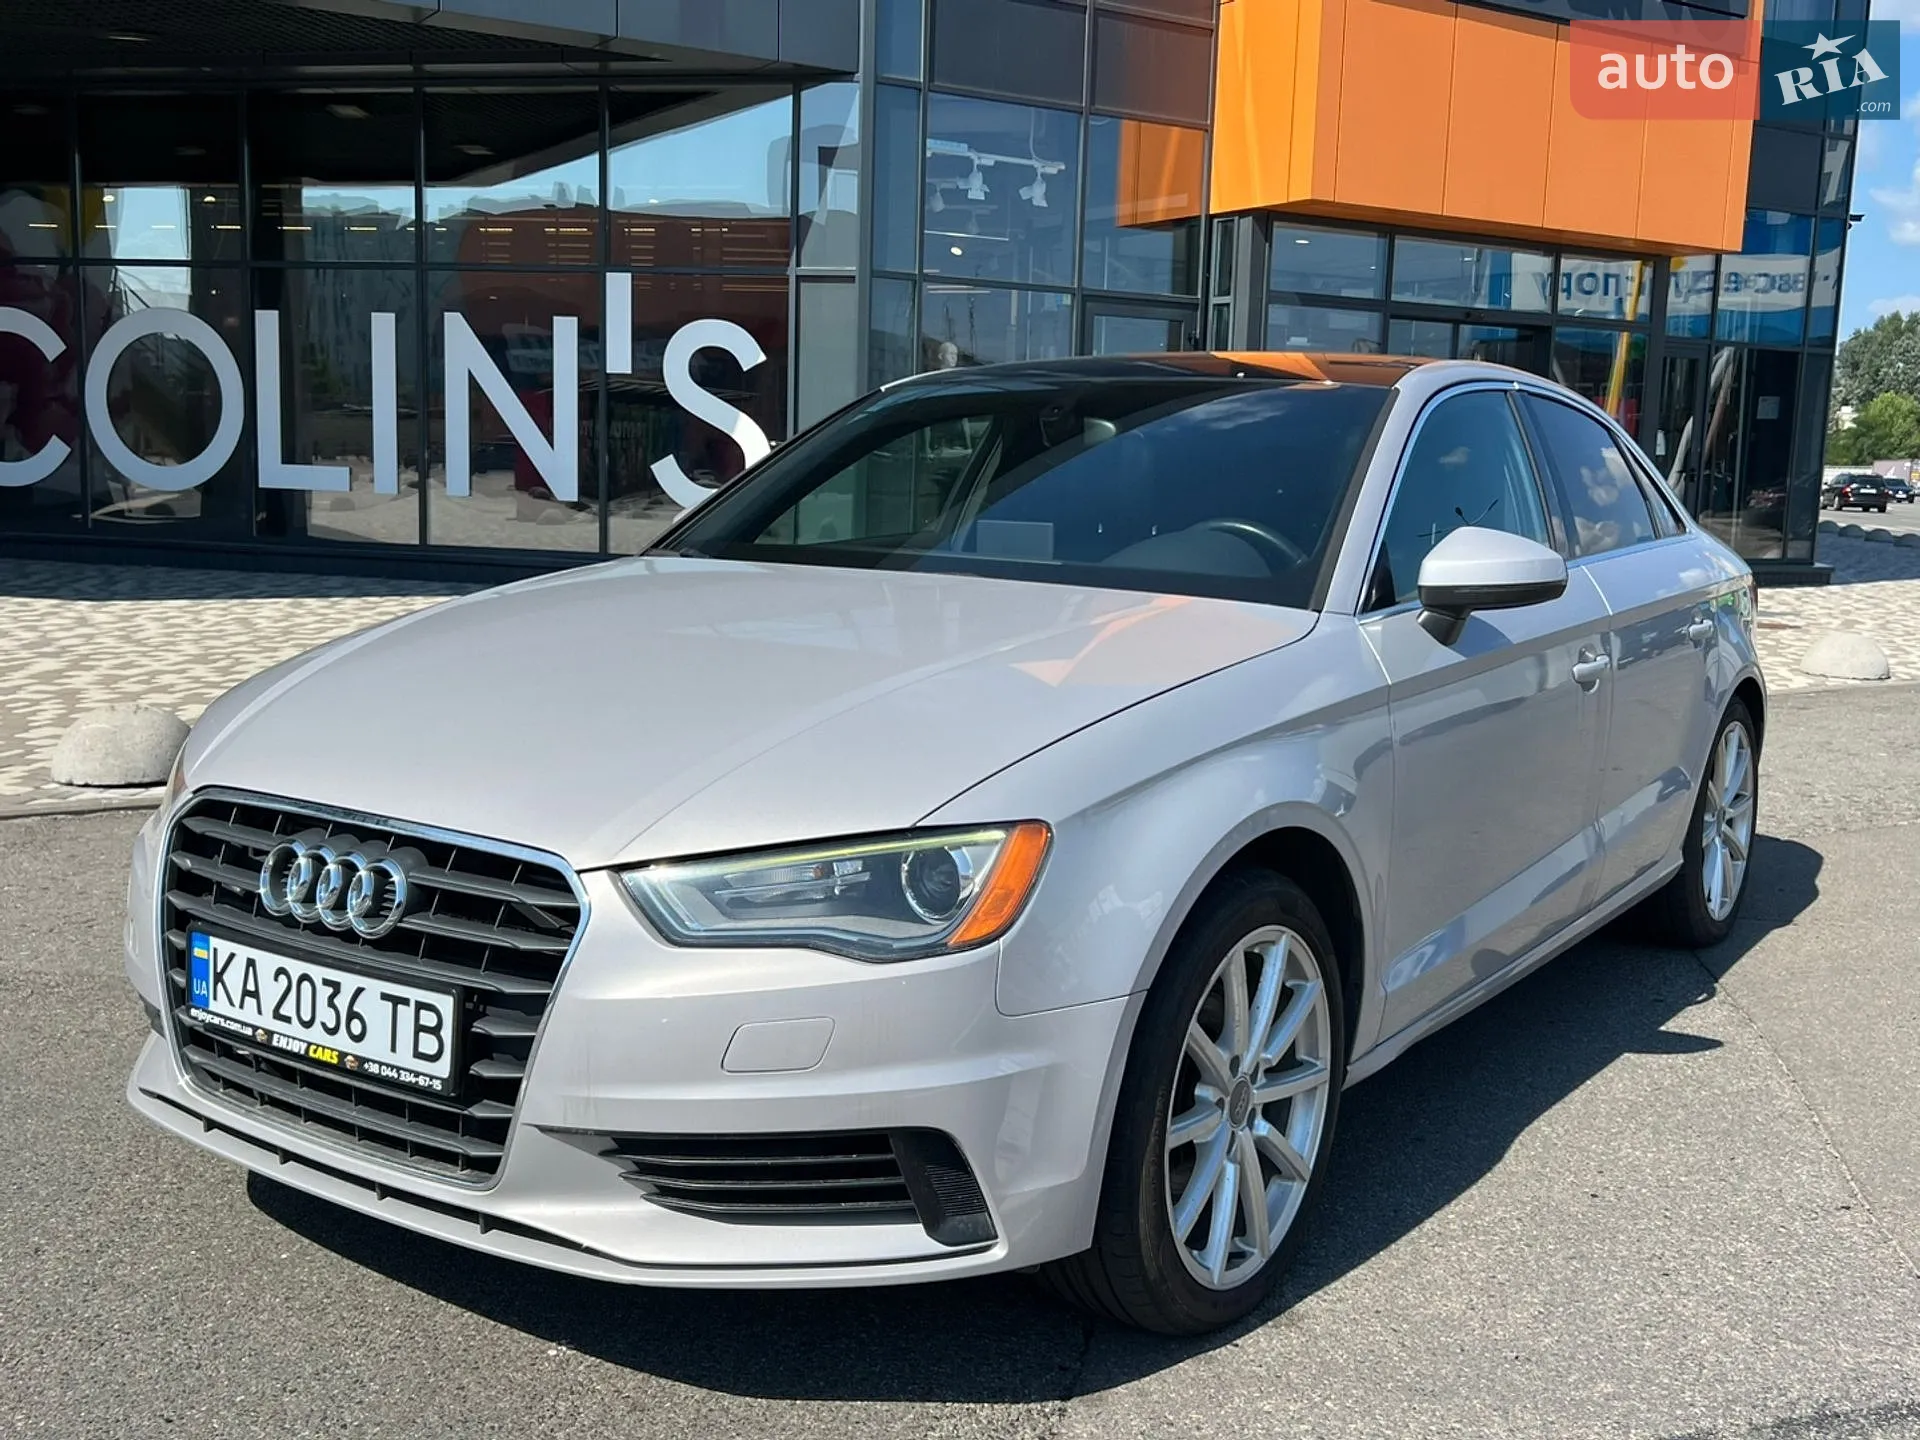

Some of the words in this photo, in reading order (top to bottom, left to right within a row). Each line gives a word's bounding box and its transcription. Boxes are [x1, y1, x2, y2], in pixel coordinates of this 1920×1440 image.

[193, 978, 208, 997] UA
[213, 947, 263, 1015] KA
[271, 966, 367, 1043] 2036
[380, 992, 445, 1063] TB
[190, 1007, 253, 1036] enjoycars.com.ua
[272, 1033, 307, 1055] ENJOY
[308, 1044, 339, 1064] CARS
[380, 1064, 398, 1079] 044
